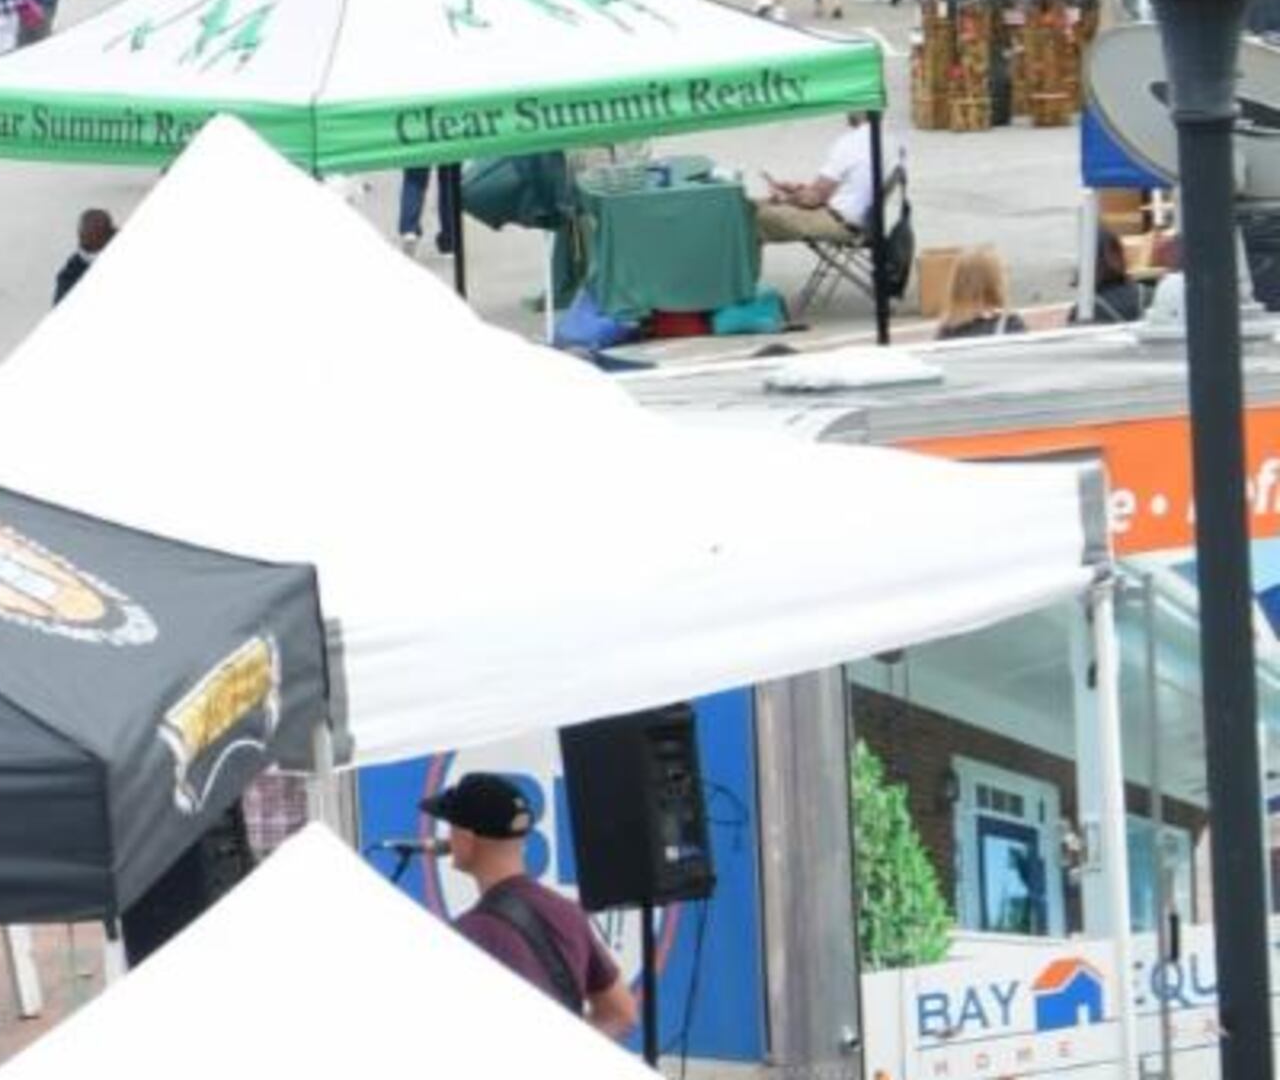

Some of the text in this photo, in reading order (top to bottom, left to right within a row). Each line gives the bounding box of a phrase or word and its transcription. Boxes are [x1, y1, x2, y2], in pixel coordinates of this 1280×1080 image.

[34, 103, 150, 146] Summit
[395, 67, 810, 146] Clear Summit Realty
[916, 980, 1020, 1037] BAY
